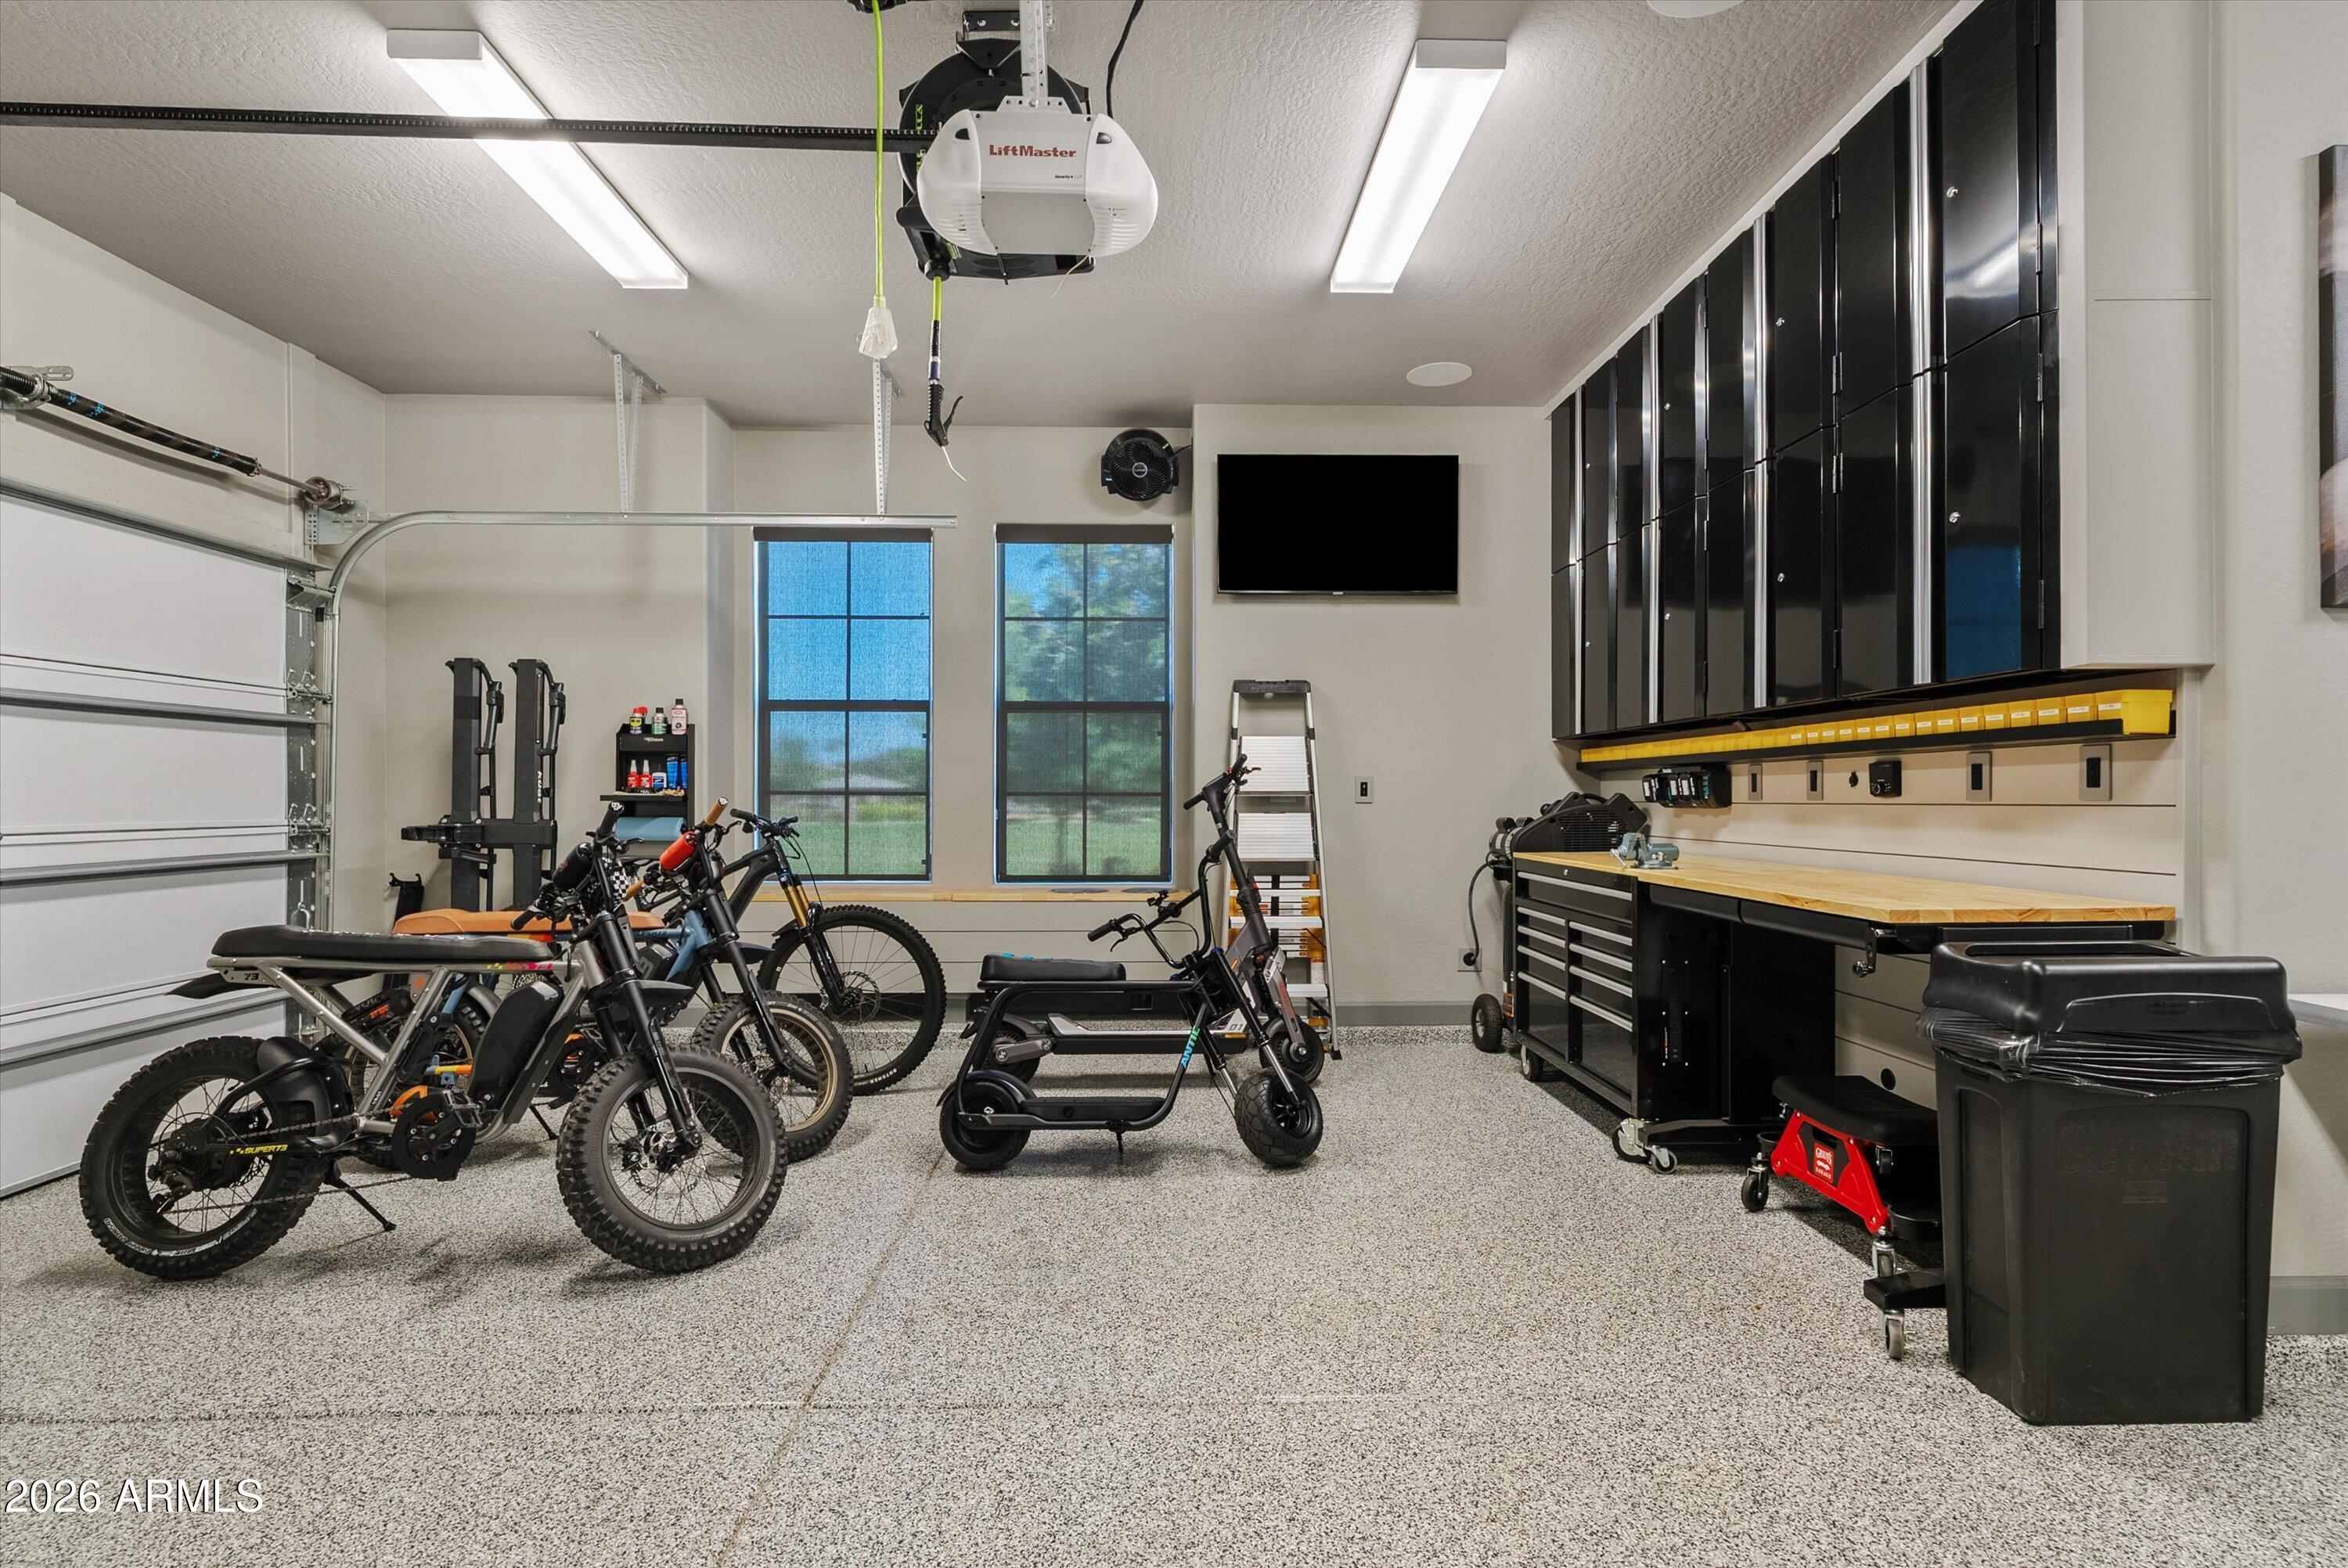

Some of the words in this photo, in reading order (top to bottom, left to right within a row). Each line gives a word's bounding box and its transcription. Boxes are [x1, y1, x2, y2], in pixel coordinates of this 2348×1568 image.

[989, 145, 1077, 157] LiftMaster
[244, 973, 260, 981] 73
[244, 1144, 288, 1154] SUPER73
[1816, 1167, 1831, 1179] GARAGE
